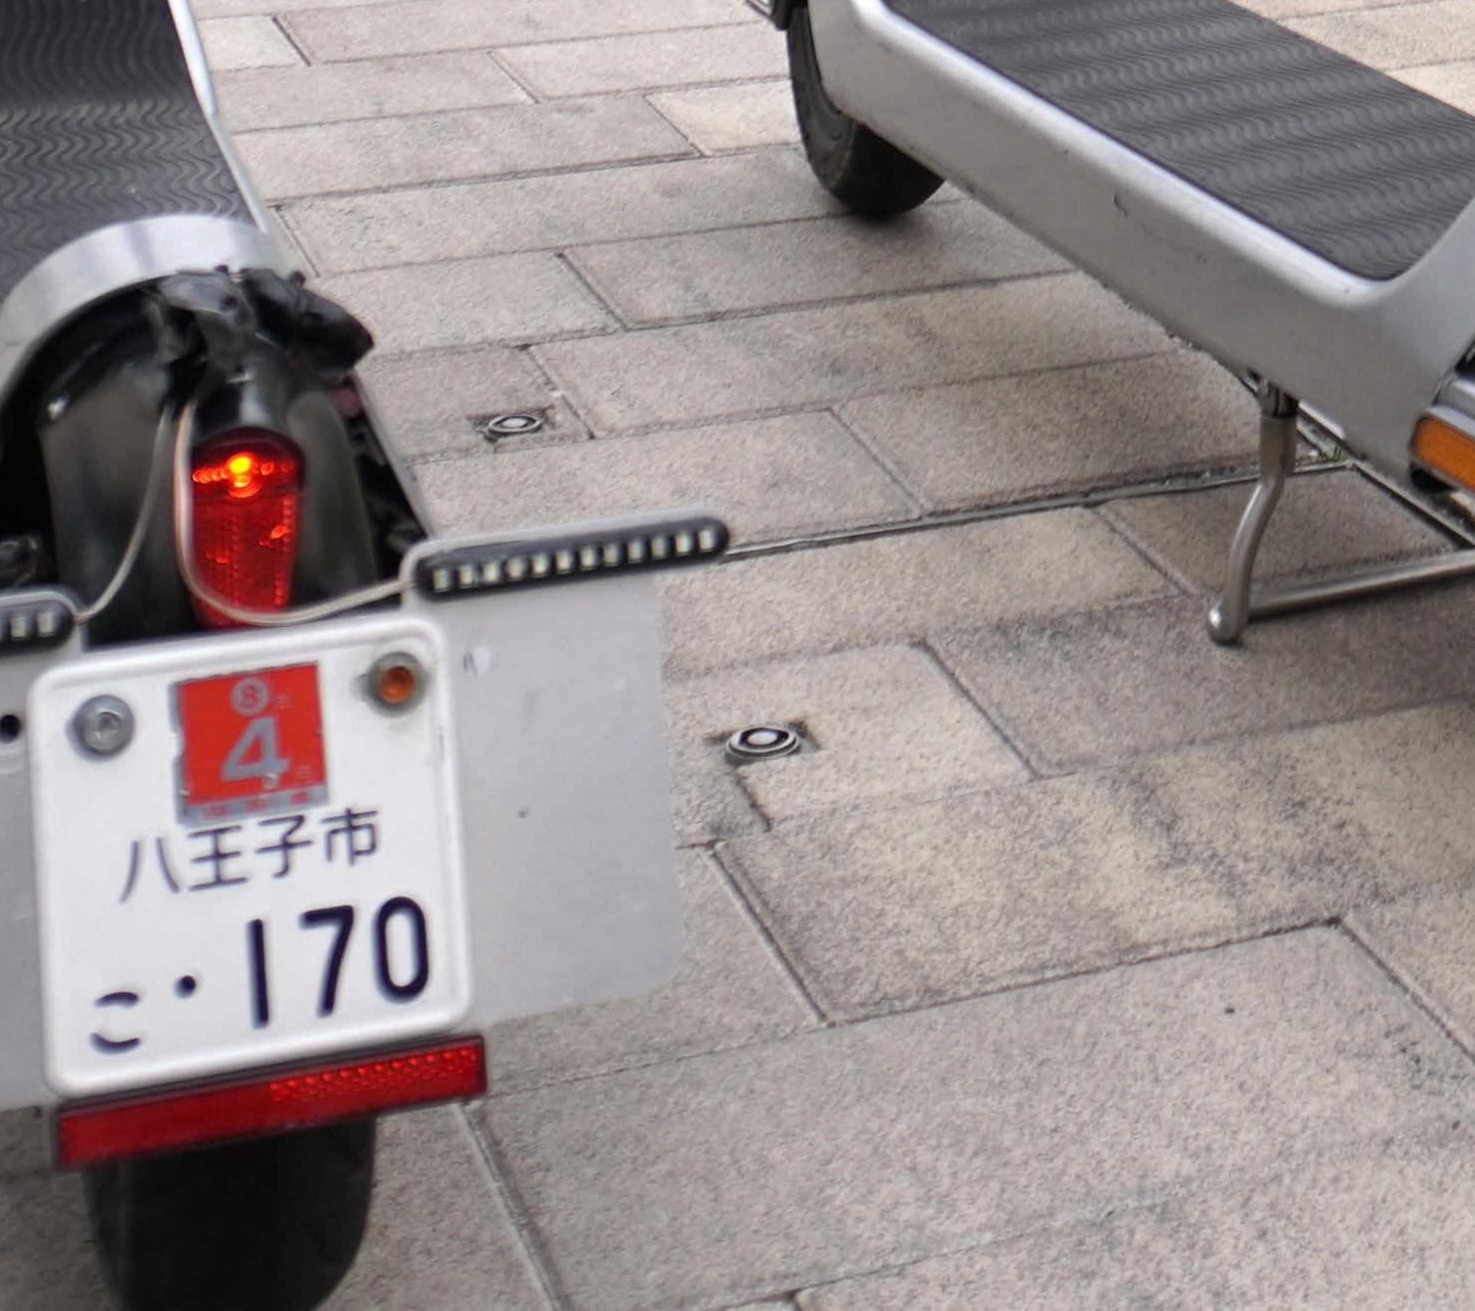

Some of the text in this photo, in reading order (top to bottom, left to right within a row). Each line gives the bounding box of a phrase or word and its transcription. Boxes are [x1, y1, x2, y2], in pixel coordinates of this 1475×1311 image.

[221, 716, 291, 789] 4
[119, 807, 379, 904] 八王子市
